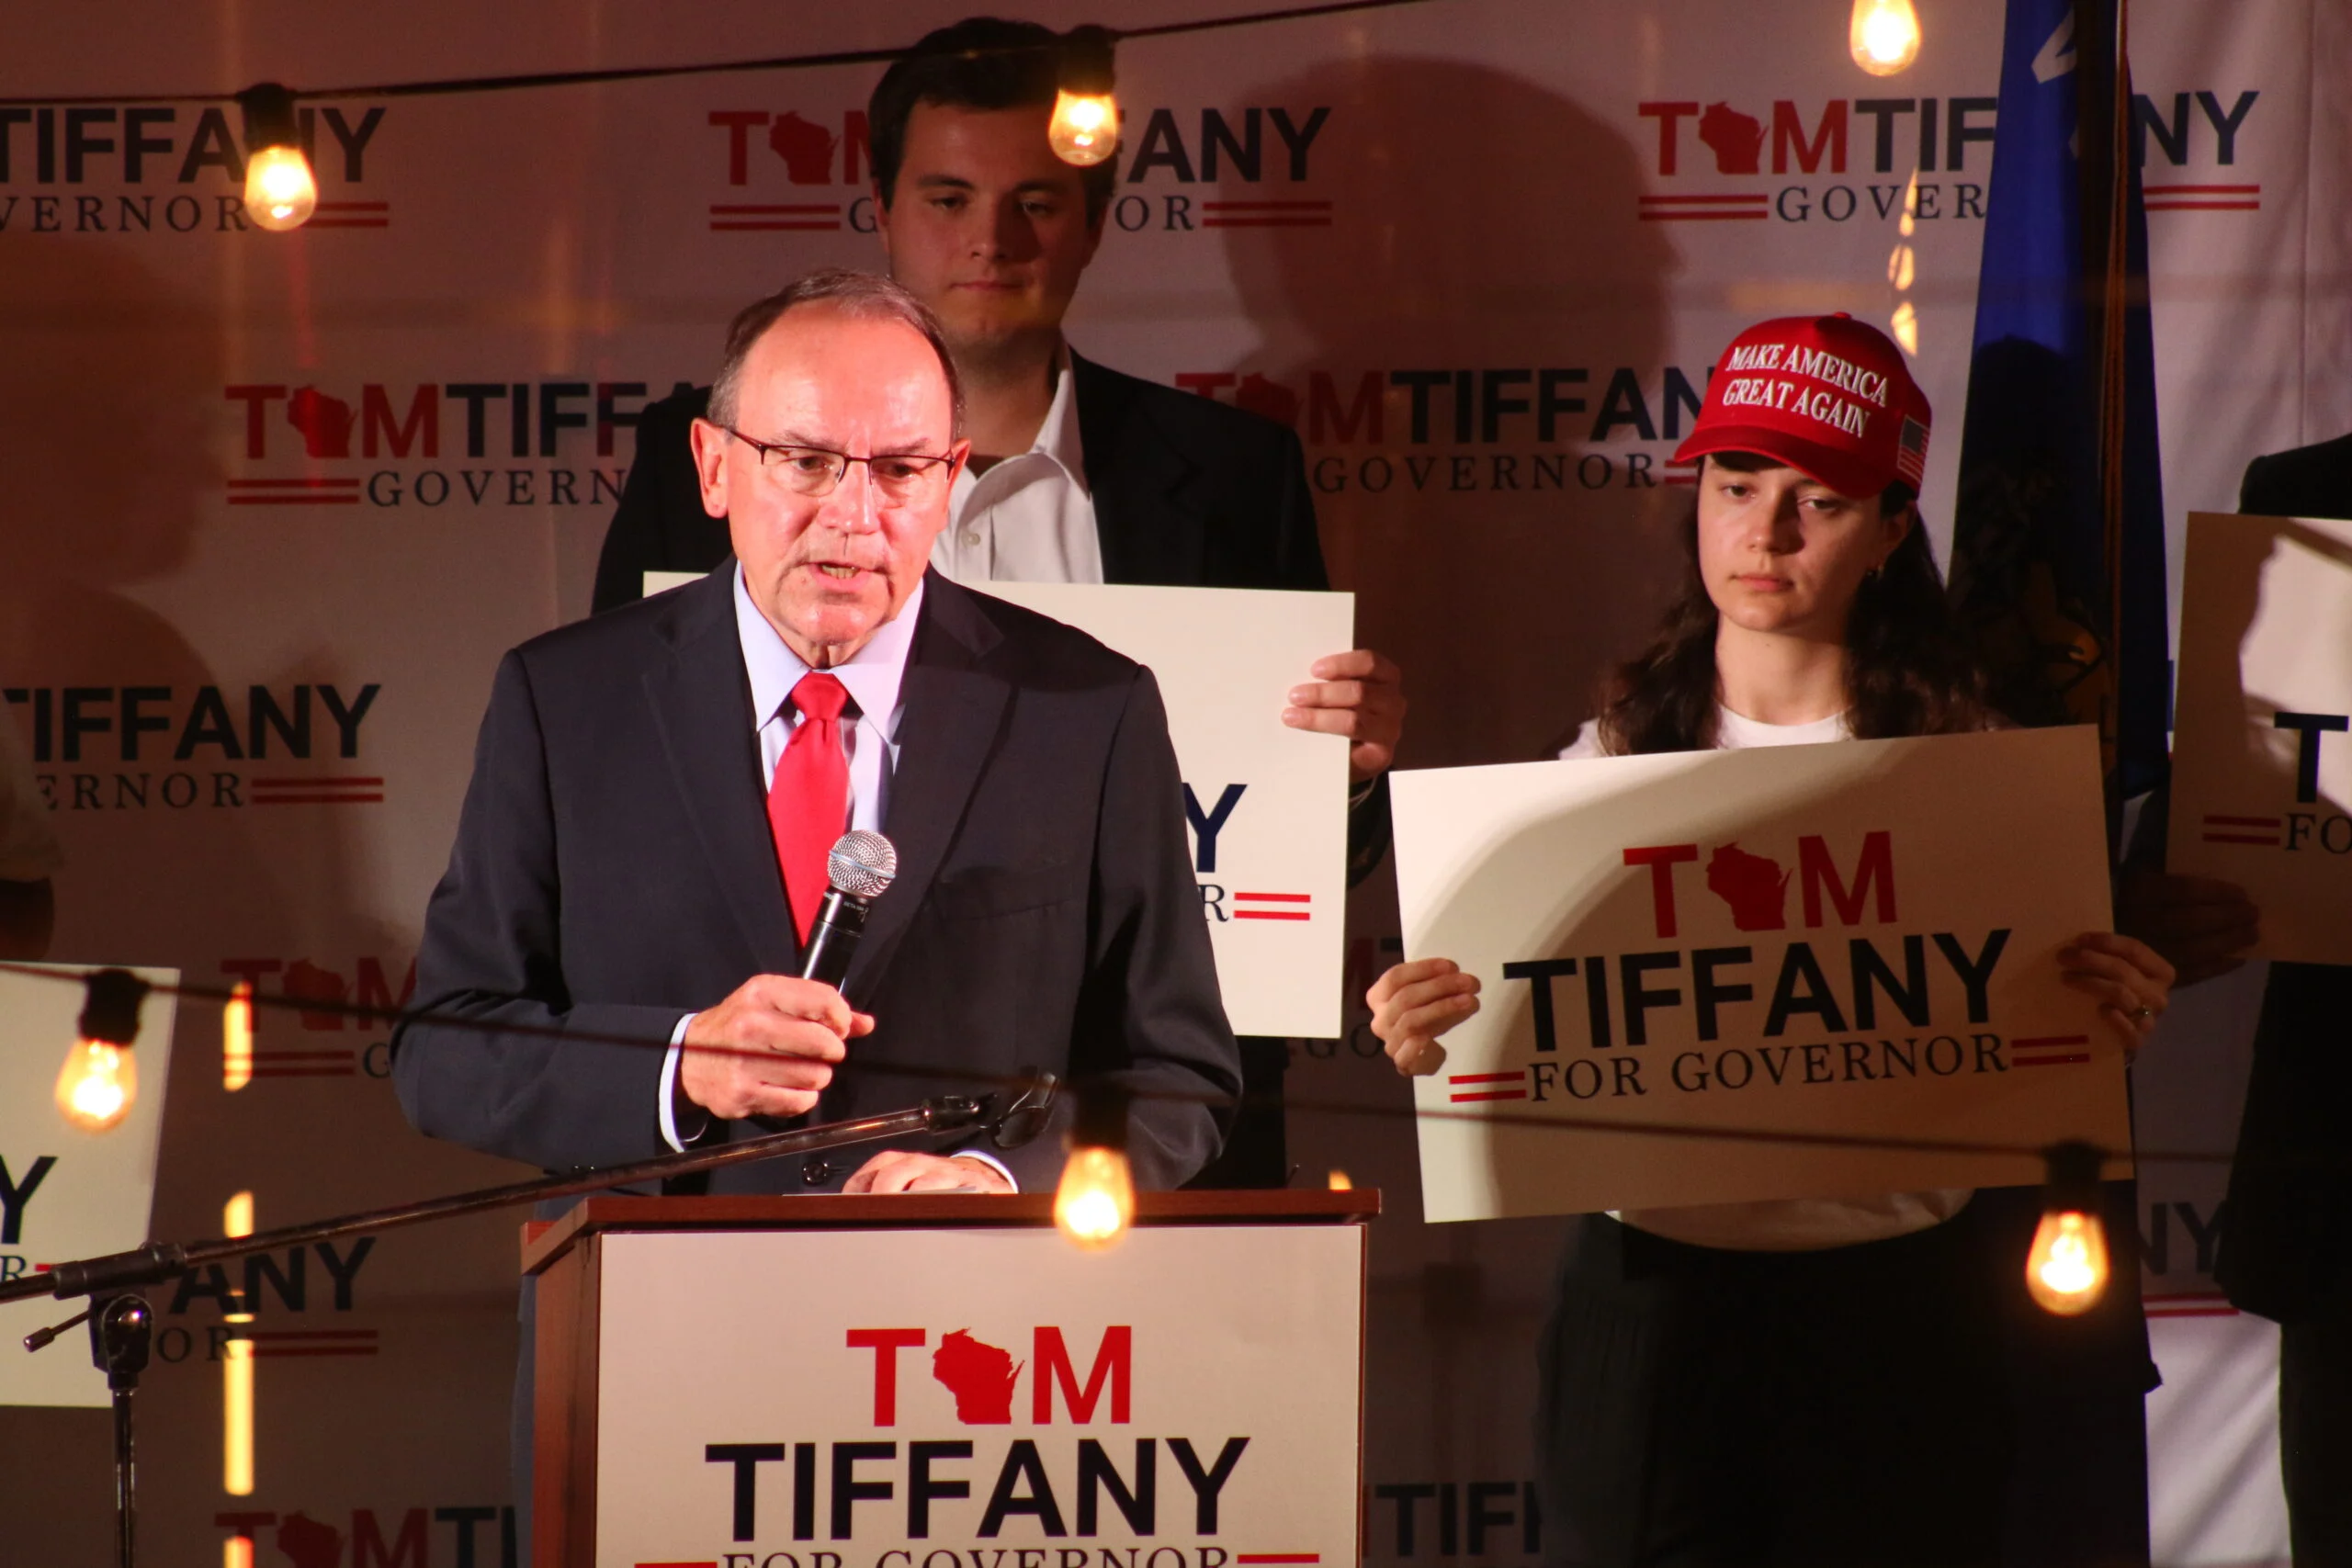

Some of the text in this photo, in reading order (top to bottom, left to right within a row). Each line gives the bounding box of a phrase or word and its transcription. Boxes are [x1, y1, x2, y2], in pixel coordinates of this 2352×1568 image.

[0, 107, 386, 183] TIFFAY
[1723, 378, 1871, 439] GREAT AGAIN
[1725, 344, 1888, 408] MAKE AMERICA
[446, 382, 695, 457] TIFF
[1314, 453, 1657, 493] GOVERNOR
[1503, 928, 2012, 1052] TIFFANY
[1529, 1032, 2009, 1102] FOR GOVERNOR
[705, 1436, 1251, 1542] TIFFANY
